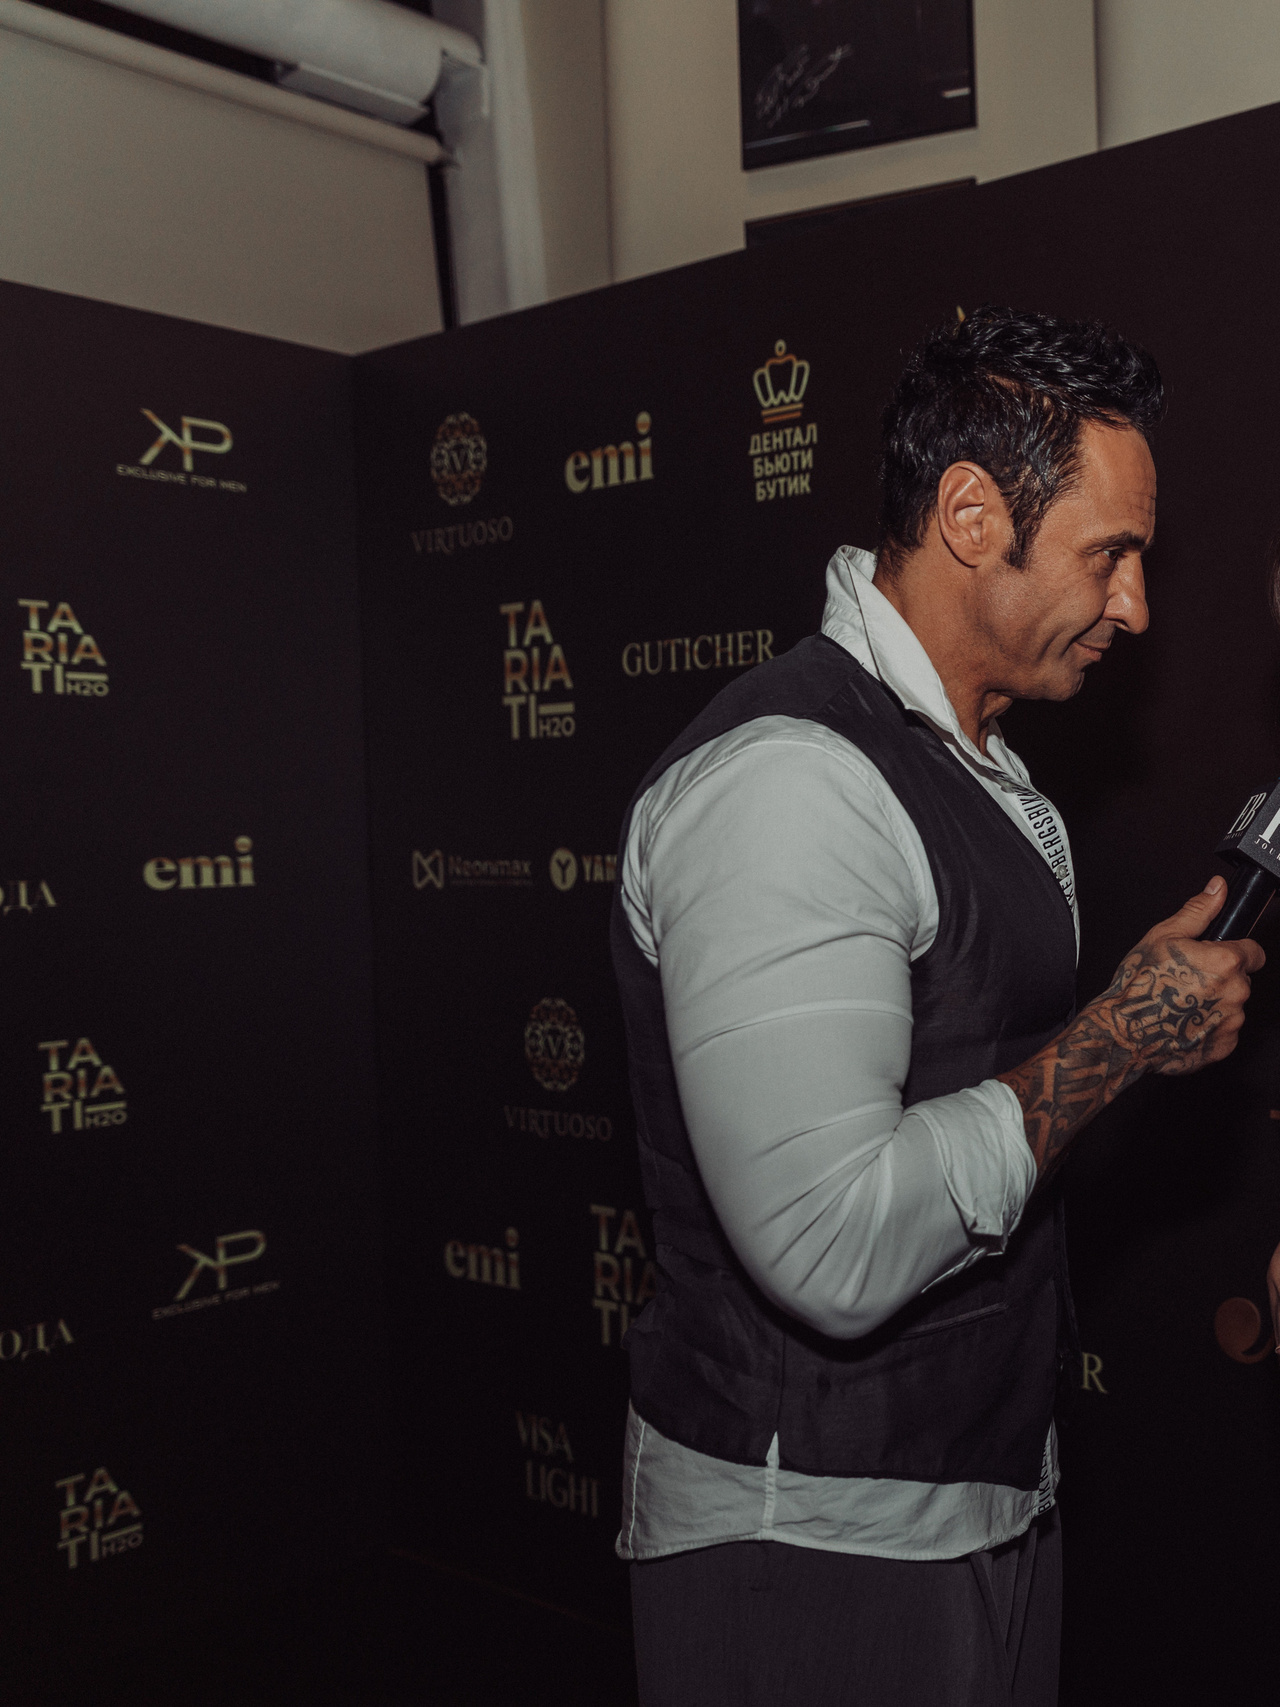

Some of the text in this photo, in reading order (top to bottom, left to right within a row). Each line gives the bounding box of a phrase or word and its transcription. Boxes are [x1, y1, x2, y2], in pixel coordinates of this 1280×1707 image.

[564, 411, 654, 493] emi
[748, 423, 818, 456] ДЕНТАЛ
[753, 448, 814, 479] БЬЮТИ
[755, 473, 812, 503] БУТИК
[411, 515, 513, 555] VIRTUOSO
[622, 629, 775, 678] GUTICHER
[539, 715, 576, 738] H2O
[1227, 792, 1267, 835] FB
[142, 835, 256, 891] emi
[0, 880, 57, 917] ДА
[503, 1104, 613, 1142] VIRTUOSO
[443, 1226, 521, 1290] emi
[515, 1410, 575, 1463] VISA
[525, 1459, 600, 1519] LIGHT
